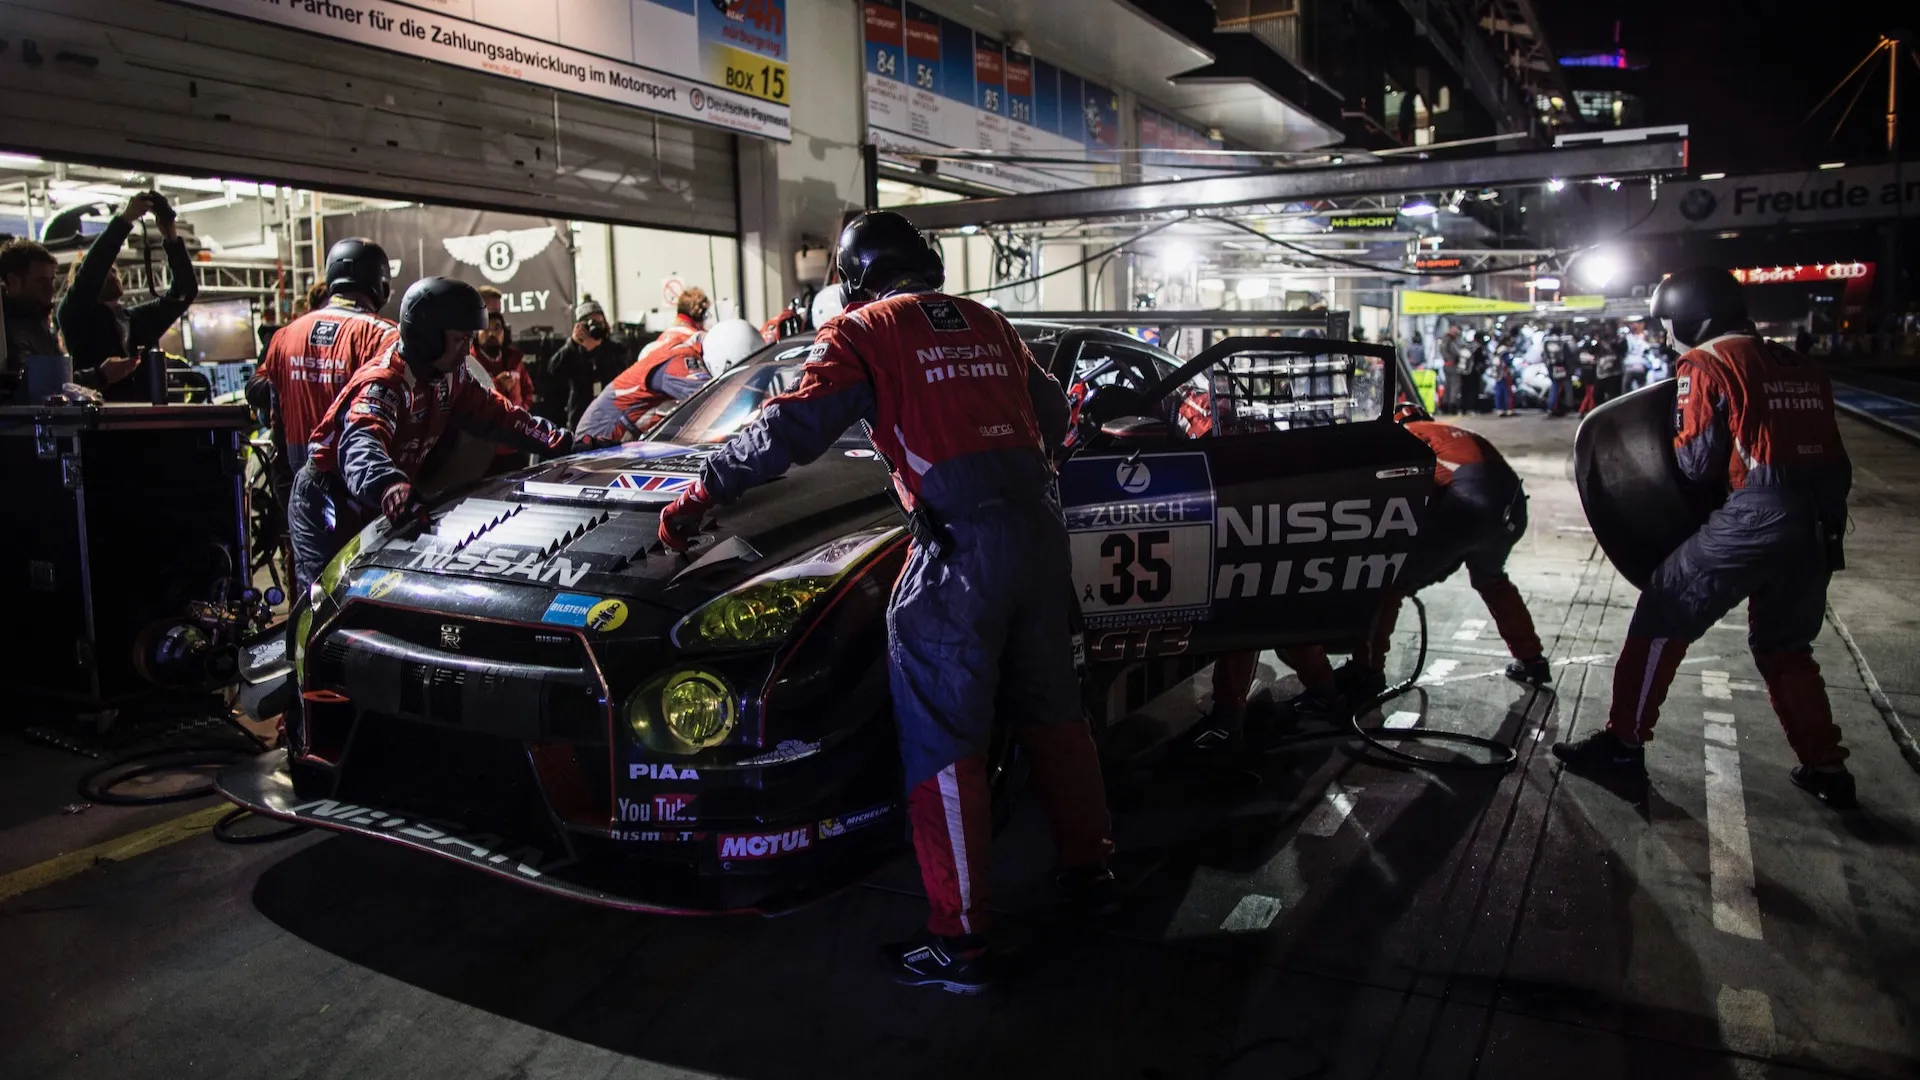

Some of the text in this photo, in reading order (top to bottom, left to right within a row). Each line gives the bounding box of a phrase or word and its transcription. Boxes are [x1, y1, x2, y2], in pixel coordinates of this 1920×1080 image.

[368, 10, 394, 32] für
[400, 19, 426, 39] die
[431, 25, 586, 82] Zahlungsabwicklung
[589, 66, 606, 84] im
[609, 70, 677, 101] Motorsport
[876, 49, 896, 77] 84
[726, 65, 785, 99] BOX 15
[917, 63, 934, 89] 56
[984, 88, 999, 112] 85
[1011, 98, 1030, 121] 311
[1733, 180, 1868, 216] Freude
[1331, 216, 1395, 228] M-SPORT
[289, 355, 346, 370] NISSAN
[916, 344, 1003, 365] NISSAN
[290, 369, 346, 384] nismo
[925, 362, 1009, 385] nismo
[1762, 381, 1821, 394] NISSAN
[1091, 502, 1184, 527] ZURICH
[1217, 497, 1429, 548] NISSA
[407, 545, 592, 588] NISSAN
[1101, 531, 1172, 606] 35
[1214, 553, 1408, 600] nism
[550, 602, 589, 617] BILSTEIN
[440, 624, 464, 633] GT
[628, 763, 700, 780] PIAA
[618, 797, 651, 823] You
[845, 805, 890, 825] MICHELIN
[721, 831, 811, 858] MOTUL
